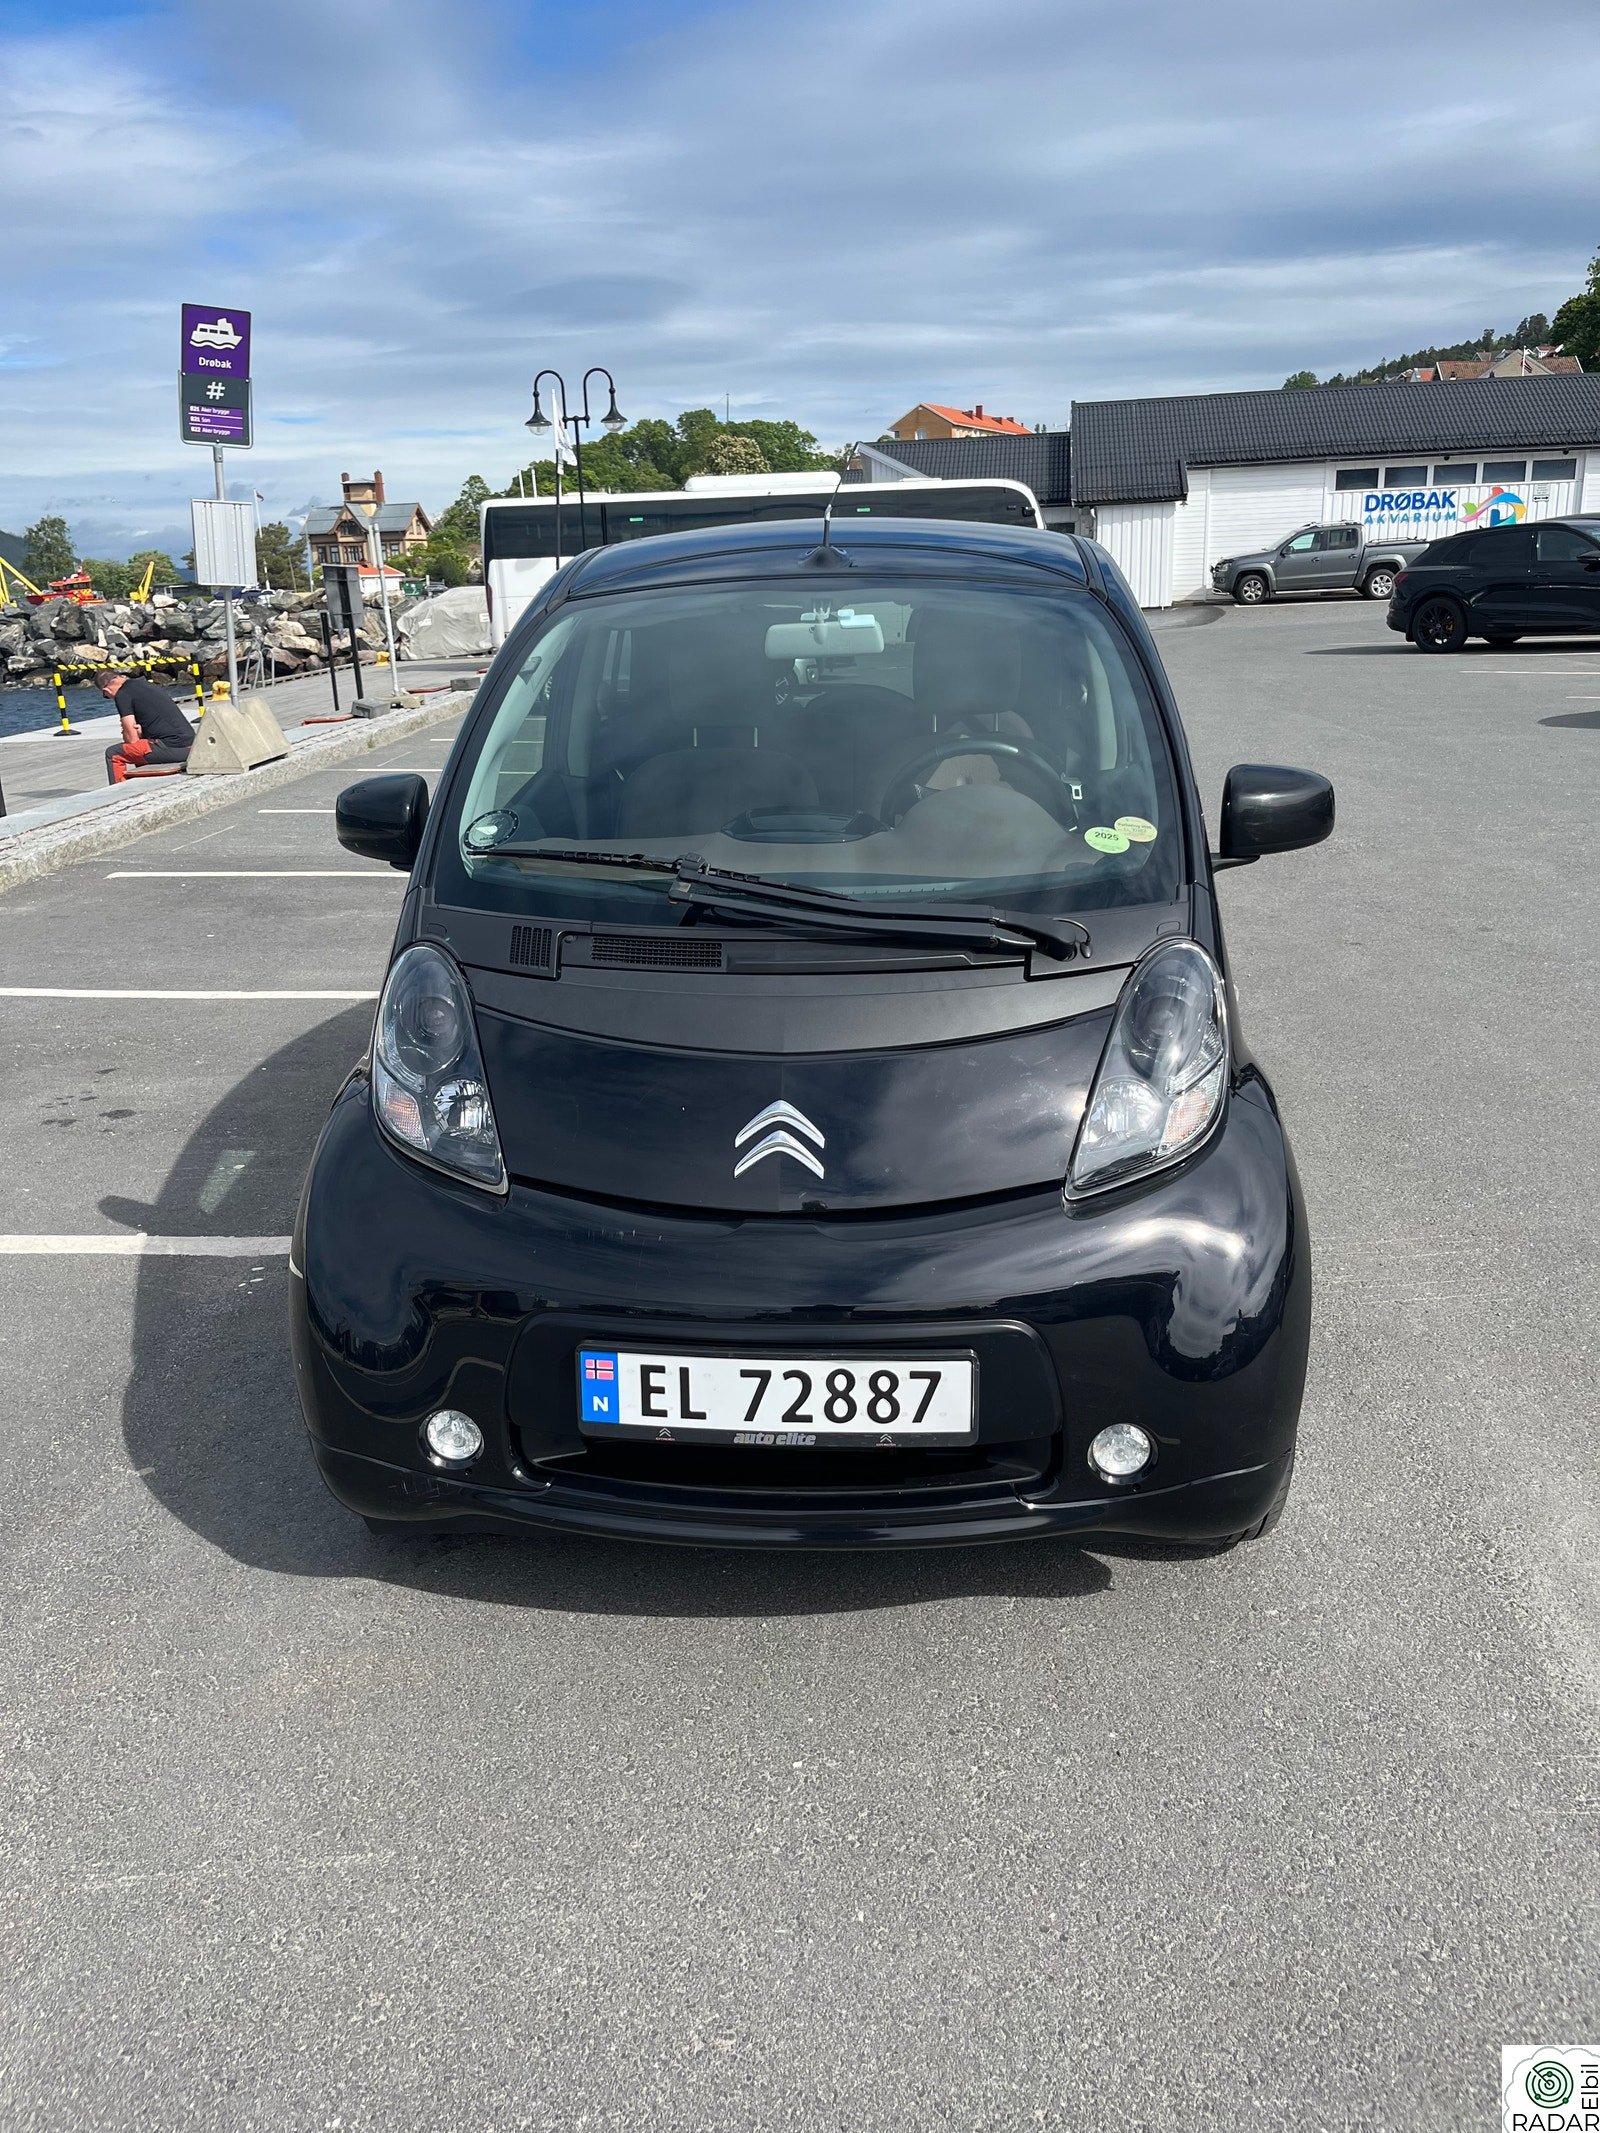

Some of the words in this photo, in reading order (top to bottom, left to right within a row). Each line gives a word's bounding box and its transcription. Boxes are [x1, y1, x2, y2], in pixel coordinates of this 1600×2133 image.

[198, 356, 232, 369] Drøbak
[1364, 490, 1457, 512] DRØBAK
[1364, 511, 1457, 525] AKVARIUM
[1094, 831, 1119, 841] 2025
[639, 1363, 707, 1420] EL
[739, 1368, 942, 1424] 72887
[592, 1395, 609, 1412] N
[733, 1432, 775, 1445] auto
[775, 1432, 816, 1446] elite
